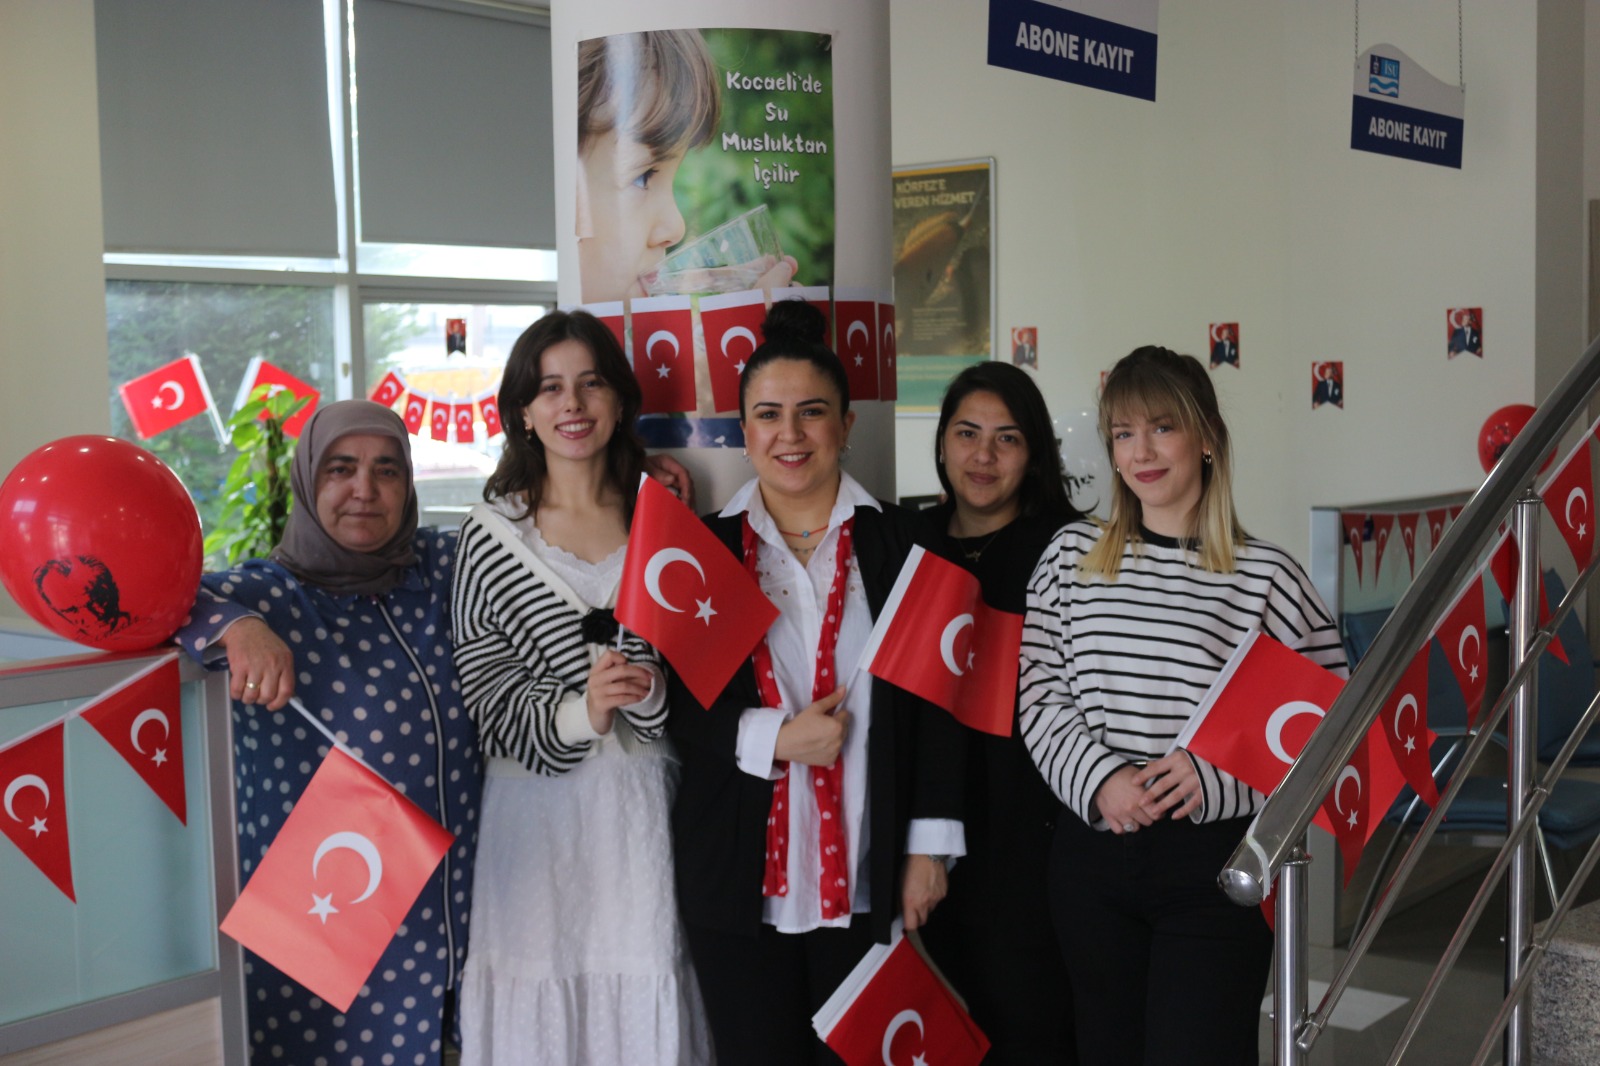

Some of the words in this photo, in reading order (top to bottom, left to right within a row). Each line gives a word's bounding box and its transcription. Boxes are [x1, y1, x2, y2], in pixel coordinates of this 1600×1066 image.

[1015, 21, 1079, 62] ABONE
[1084, 38, 1134, 74] KAYIT
[726, 71, 822, 93] Kocaeli'de
[765, 102, 788, 121] Su
[722, 132, 827, 153] Musluktan
[1368, 116, 1410, 143] ABONE
[1413, 125, 1448, 150] KAYIT
[754, 157, 800, 189] İçilir
